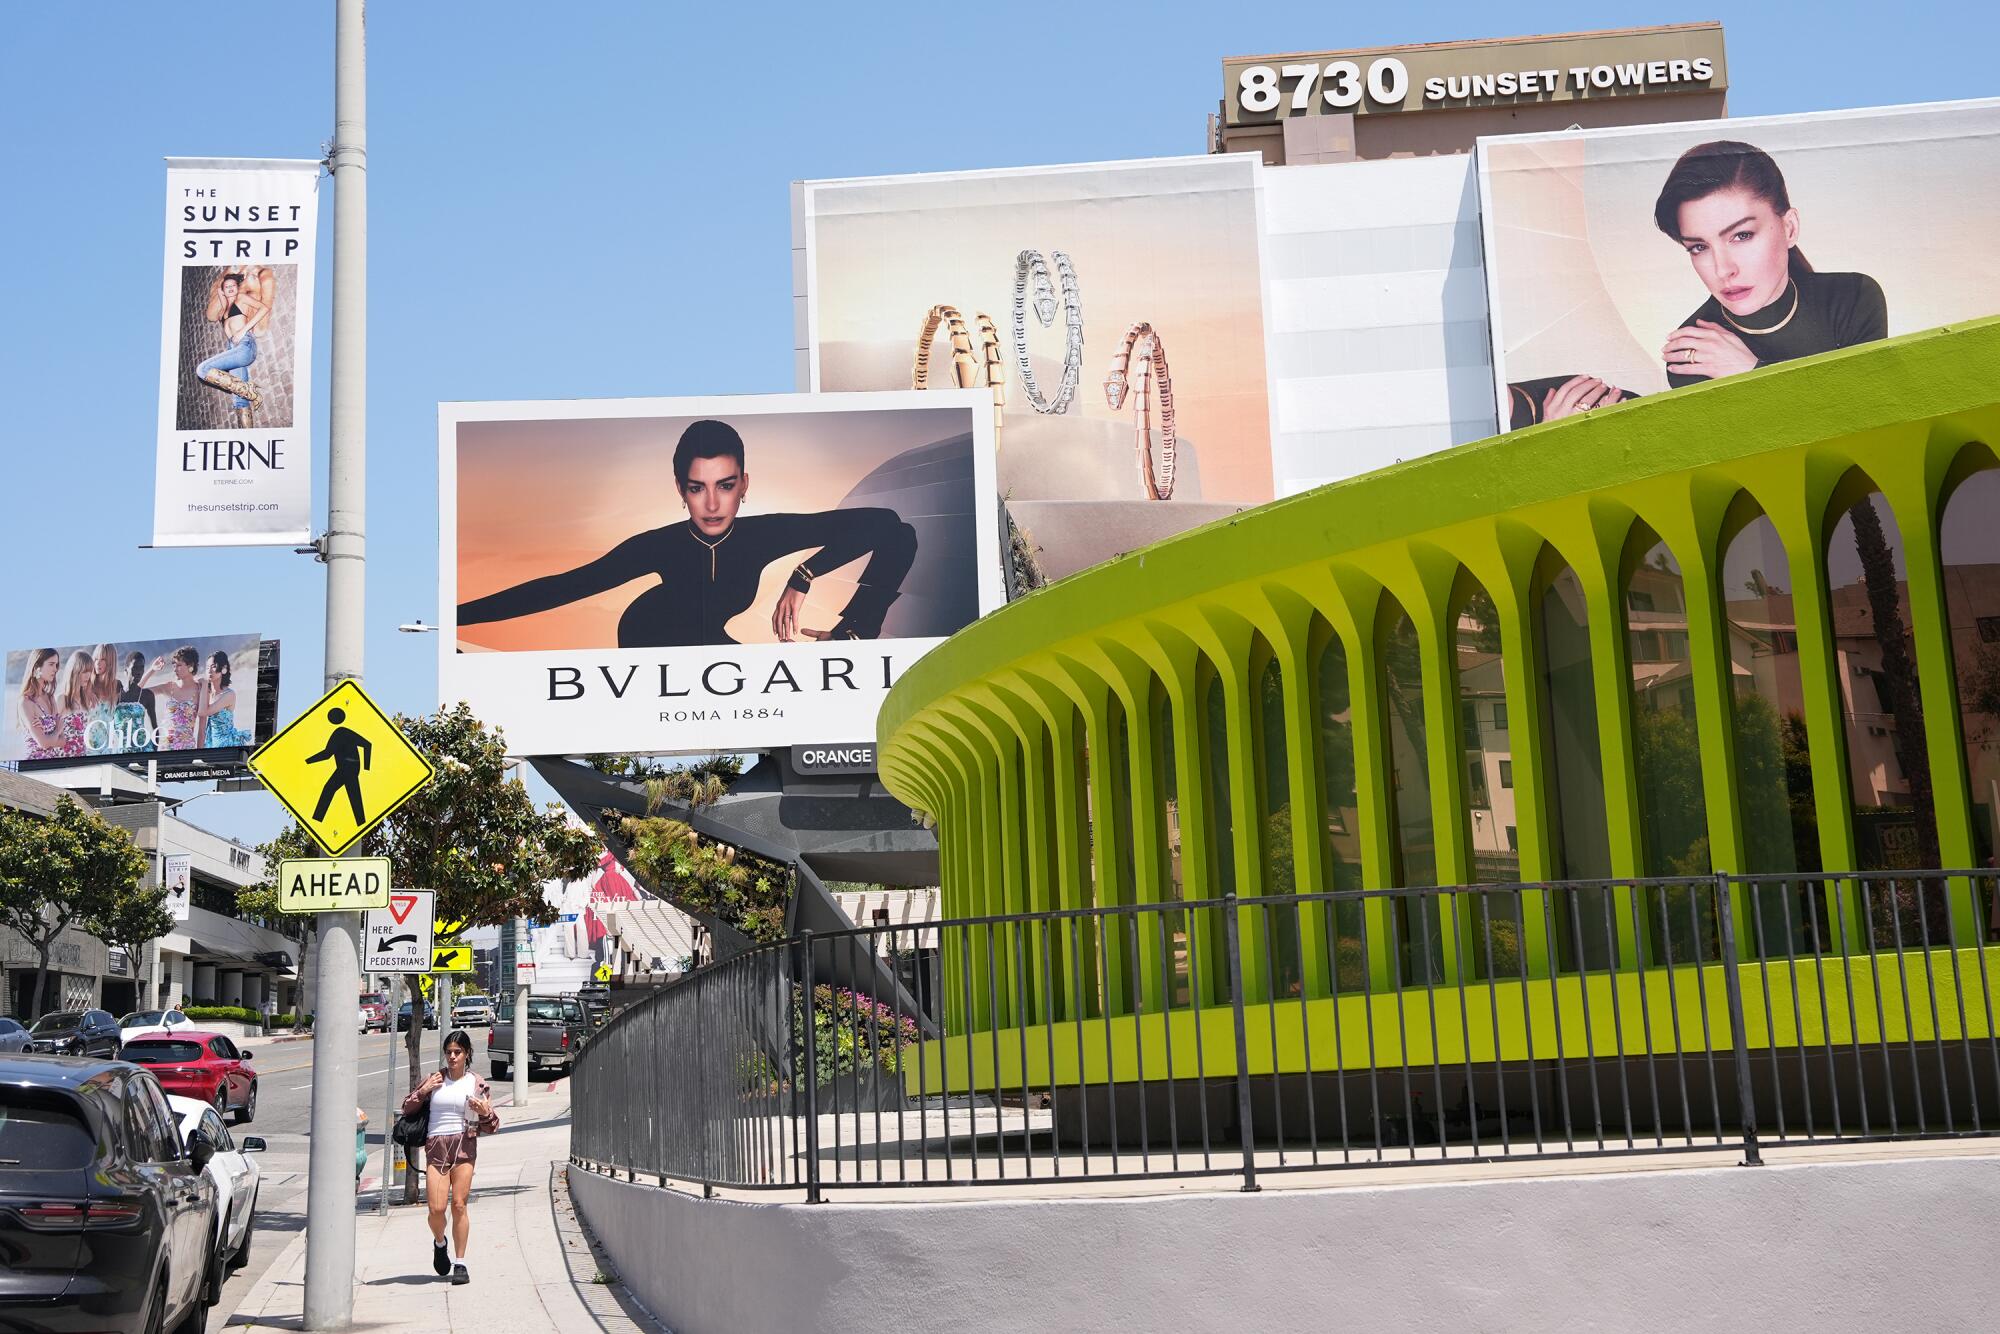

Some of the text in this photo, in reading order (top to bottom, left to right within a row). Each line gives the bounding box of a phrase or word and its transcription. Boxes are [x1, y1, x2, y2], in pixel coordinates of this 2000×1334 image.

[1238, 57, 1714, 112] 8730 SUNSET TOWERS
[184, 188, 217, 198] THE
[183, 205, 301, 222] SUNSET
[183, 239, 299, 258] STRIP
[182, 439, 285, 472] ÉTERNE
[187, 502, 279, 513] thesunsetstrip.com
[546, 655, 893, 701] BVLGARI
[659, 707, 785, 723] ROMA 1884
[83, 717, 170, 751] Chloé
[802, 749, 873, 765] ORANGE
[164, 769, 231, 779] ORANGE BARREL MEDIA
[290, 872, 380, 897] AHEAD
[372, 926, 394, 934] HERE
[407, 946, 417, 955] TO
[370, 957, 425, 966] PEDESTRIANS
